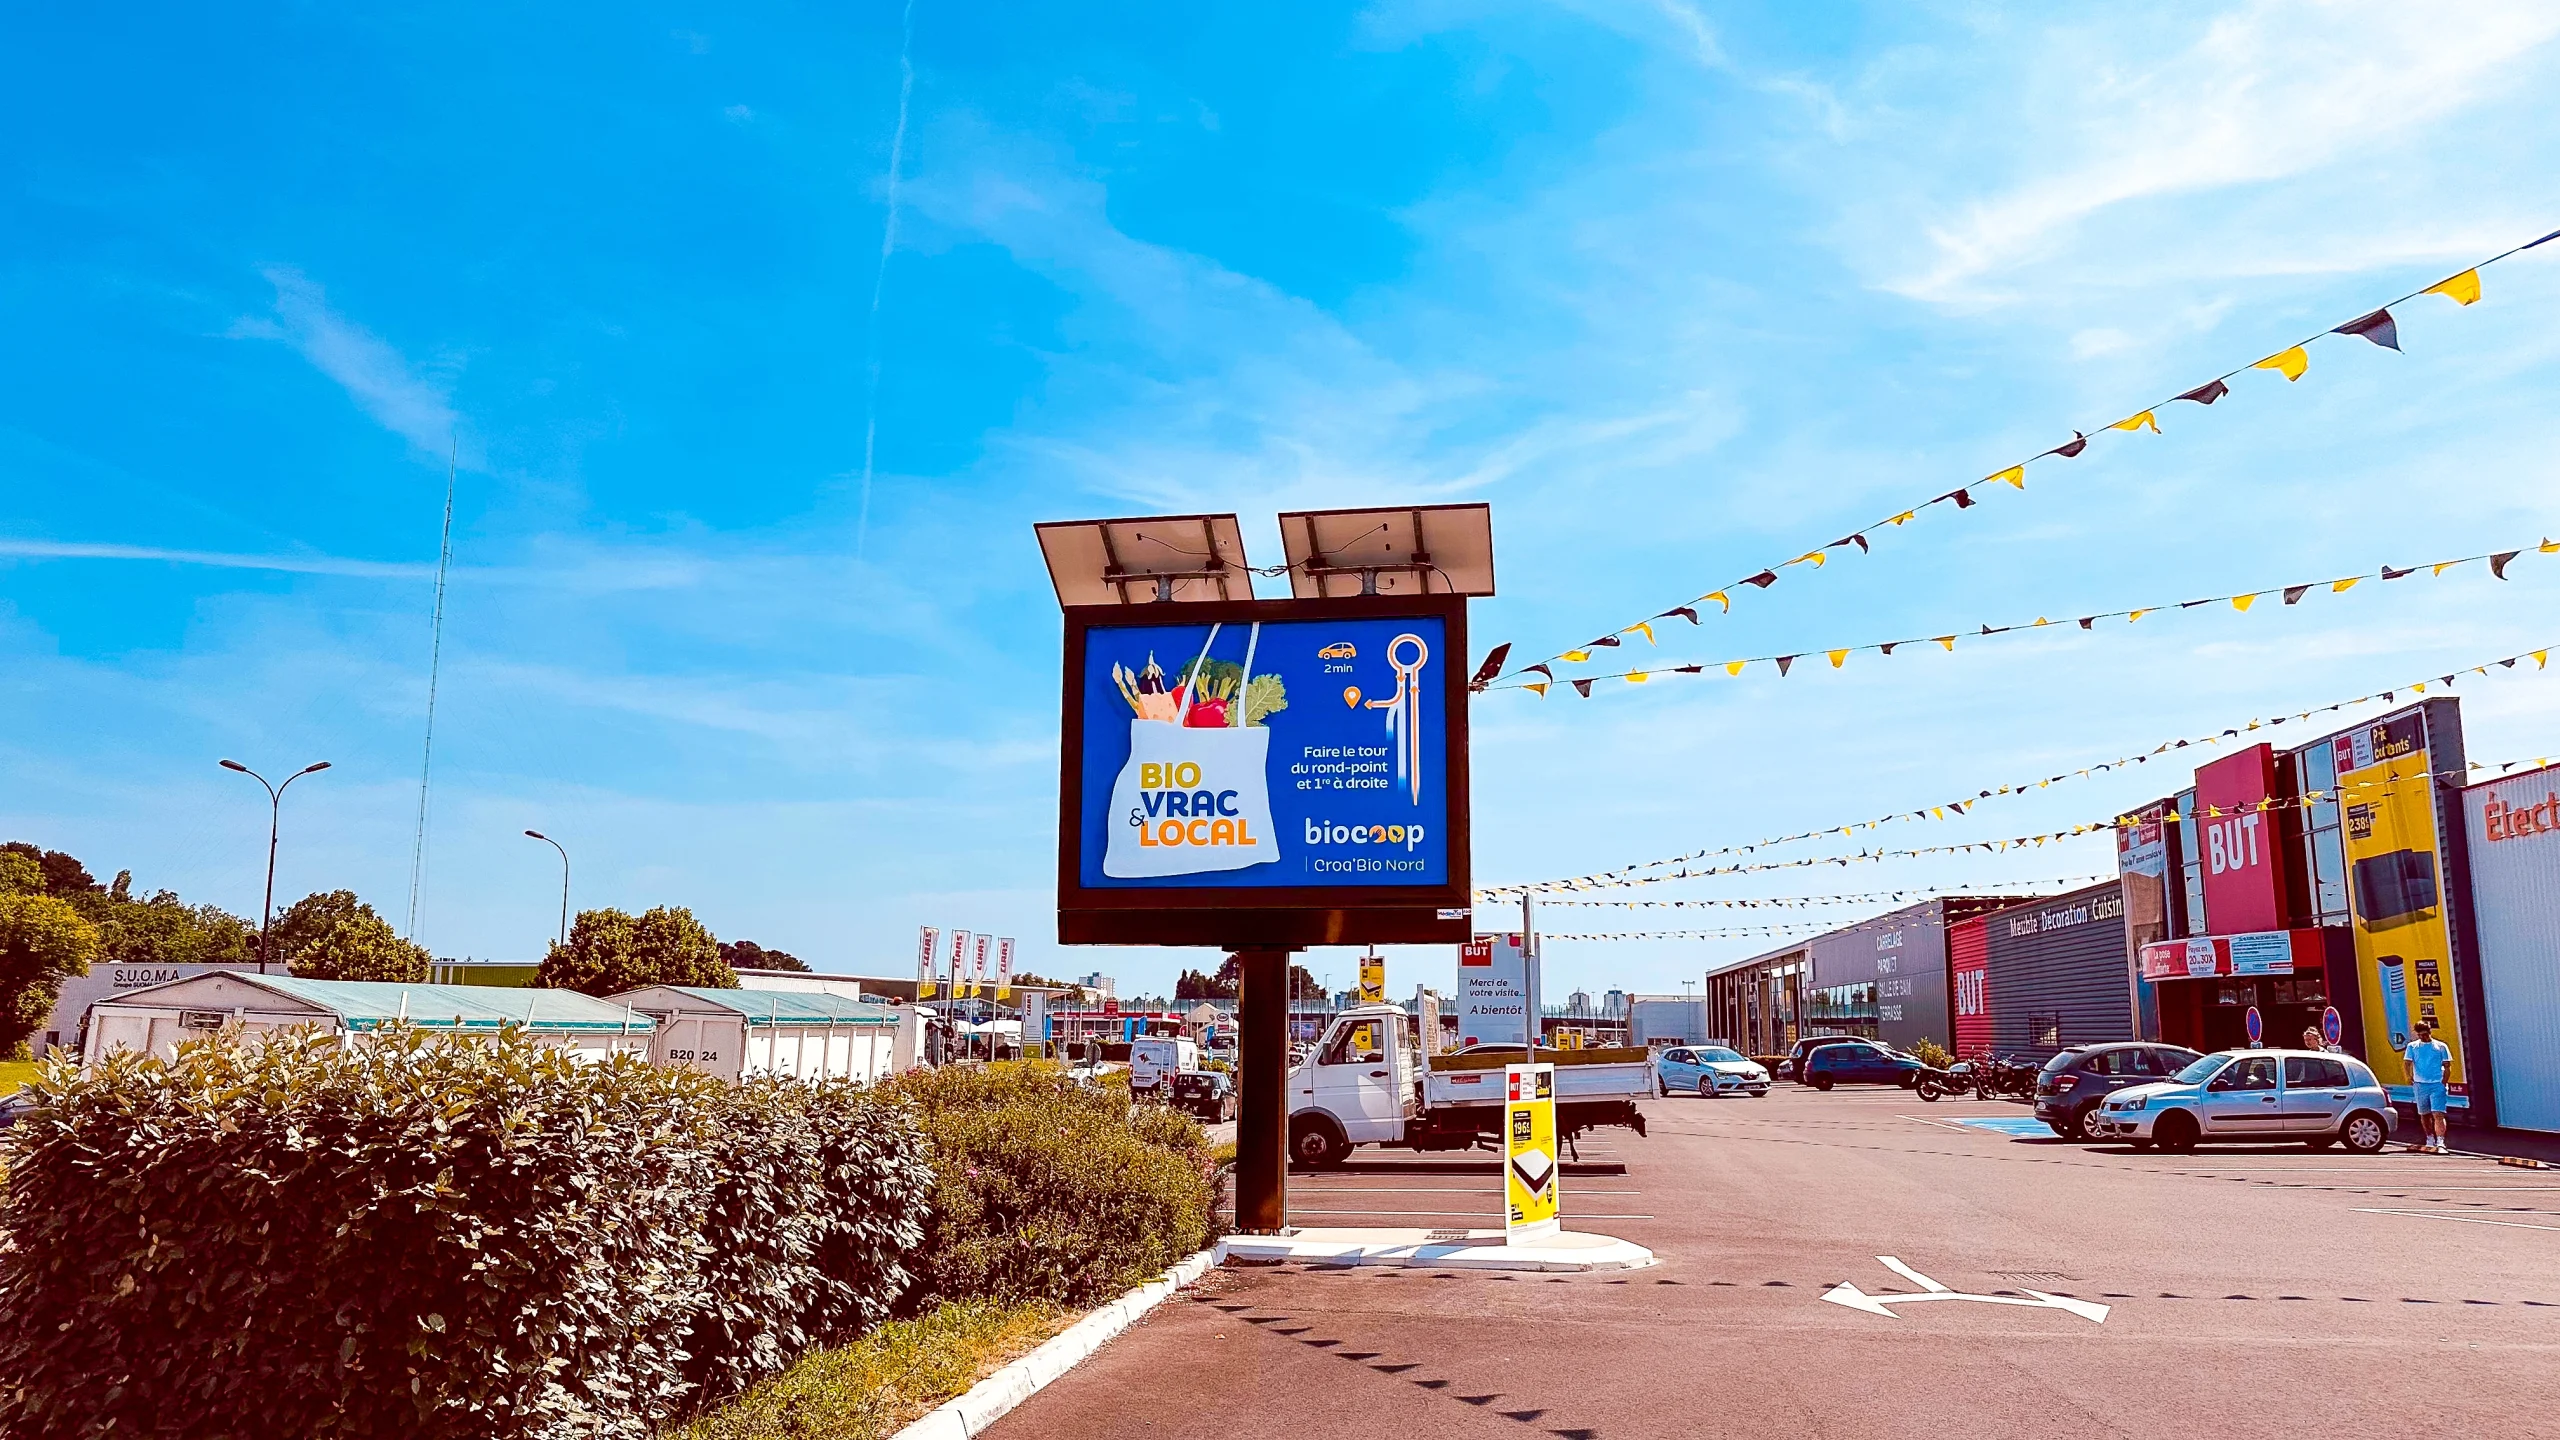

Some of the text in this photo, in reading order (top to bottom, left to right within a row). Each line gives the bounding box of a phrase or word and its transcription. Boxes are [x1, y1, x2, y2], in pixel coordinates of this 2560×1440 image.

[1324, 663, 1353, 673] 2 min
[1304, 745, 1388, 758] Faire le tour
[2337, 748, 2351, 761] BUT
[1141, 761, 1202, 789] BIO
[1291, 761, 1388, 776] du rond-point
[1296, 778, 1312, 790] et
[1333, 776, 1344, 790] à
[1345, 776, 1388, 789] droite
[1140, 789, 1240, 818] VRAC
[1129, 807, 1258, 847] & LOCAL
[1305, 817, 1425, 853] biocoop
[2208, 812, 2259, 875] BUT
[1314, 857, 1425, 873] Croq'Bio Nord
[2010, 913, 2038, 937] Meuble
[2041, 908, 2088, 932] Décoration
[923, 930, 933, 968] CLAAS
[1876, 929, 1903, 952] CARRELAGE
[954, 933, 963, 969] CLAAS
[1000, 941, 1009, 974] CLAAS
[1464, 946, 1489, 957] BUT
[2189, 955, 2197, 965] 20
[1877, 955, 1897, 974] PARQUET
[1469, 979, 1508, 987] Merci de
[1469, 988, 1493, 997] votre
[1956, 969, 1985, 1016] BUT
[1469, 1004, 1523, 1016] A bientôt
[1879, 1004, 1903, 1022] TERRASSE
[670, 1049, 718, 1062] B20 24
